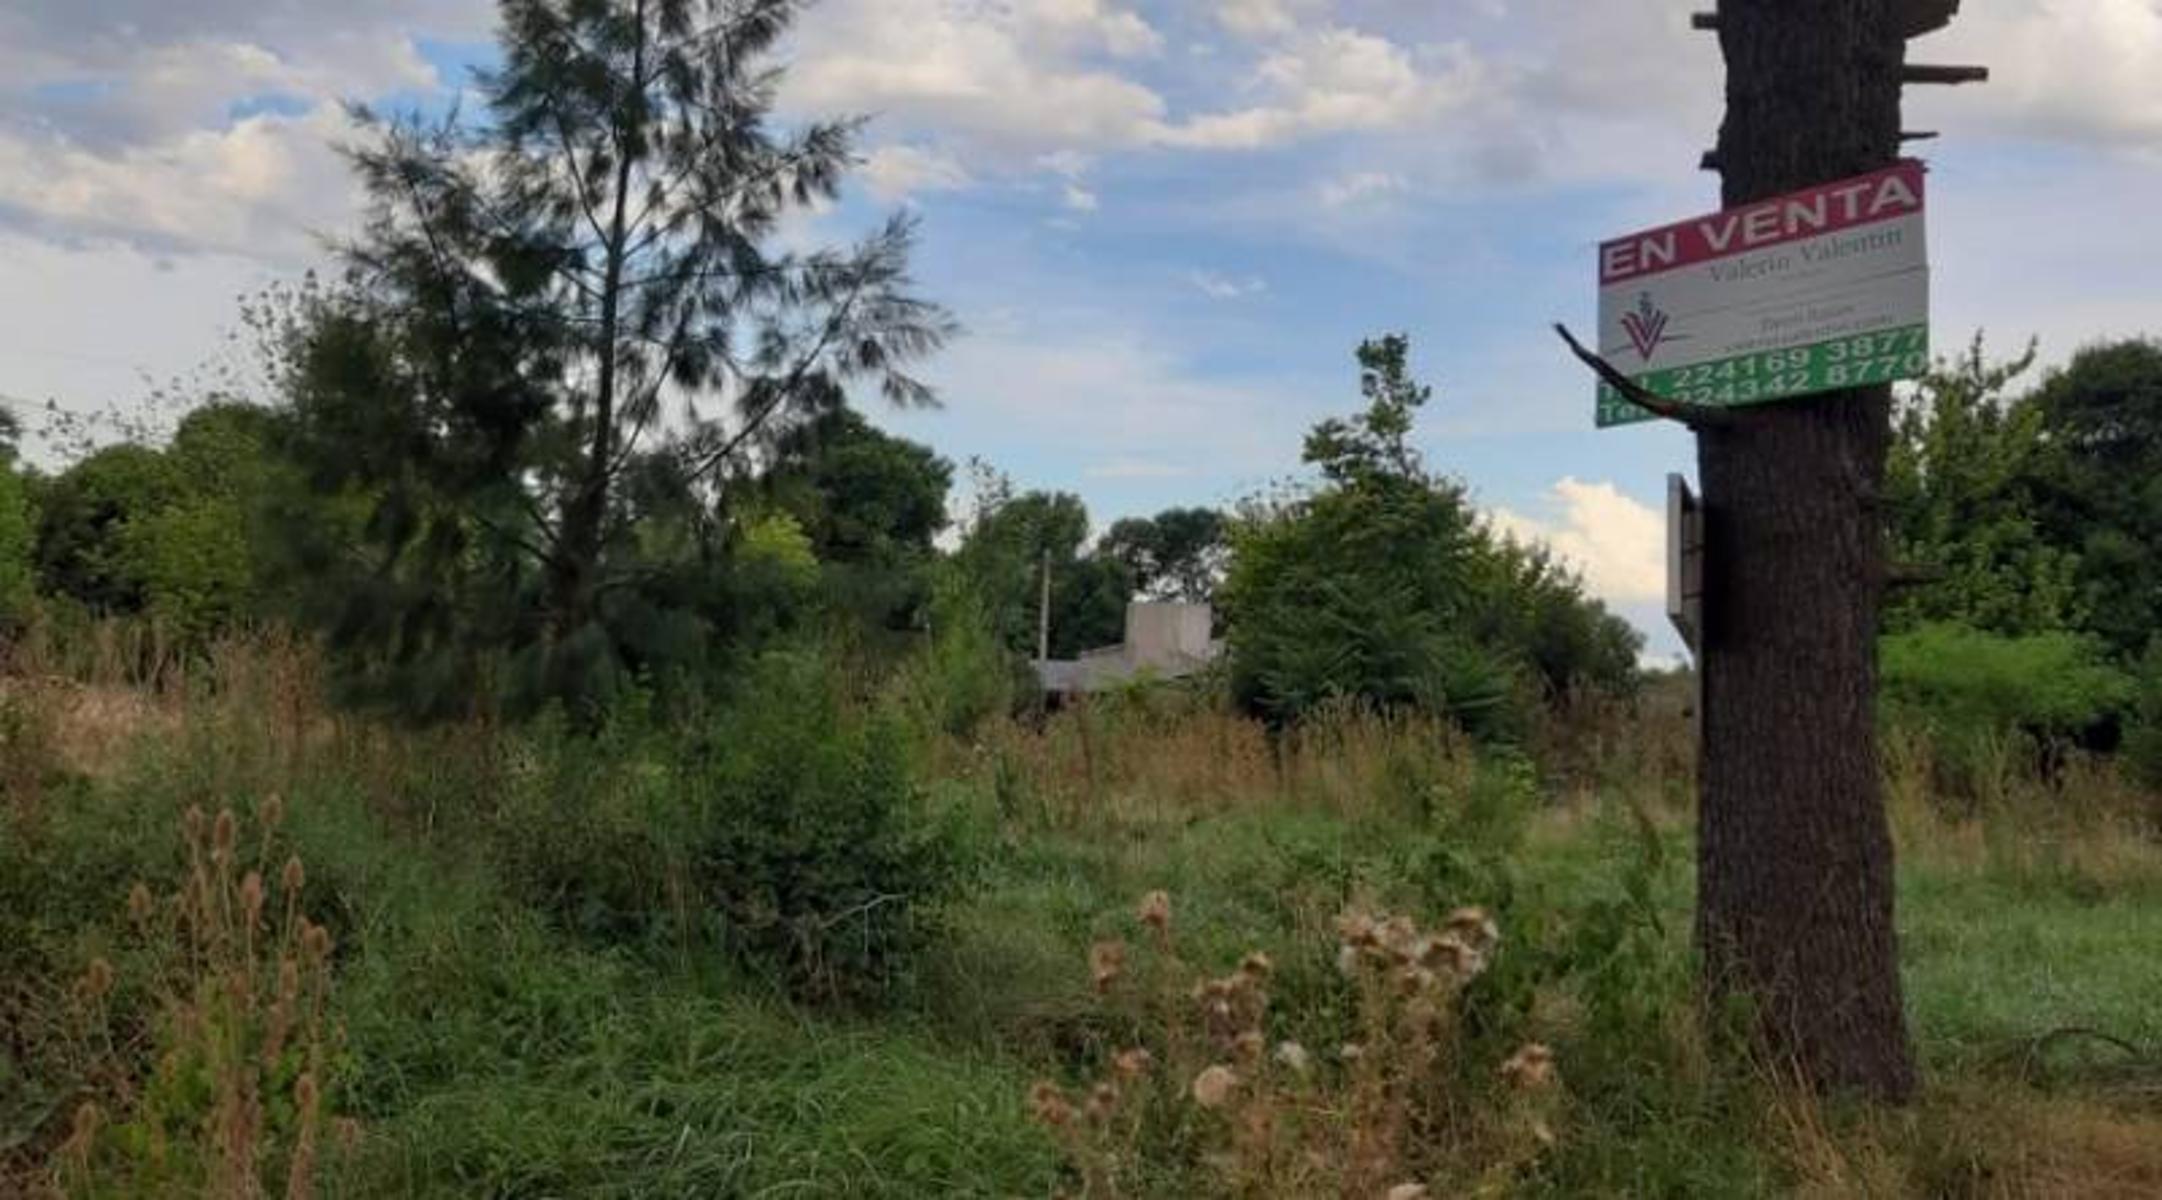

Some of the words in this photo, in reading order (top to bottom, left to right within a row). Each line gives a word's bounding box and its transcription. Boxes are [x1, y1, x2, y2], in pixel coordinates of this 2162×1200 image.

[1603, 232, 1676, 278] EN
[1701, 175, 1917, 252] VENTA
[1824, 327, 1926, 362] 3877
